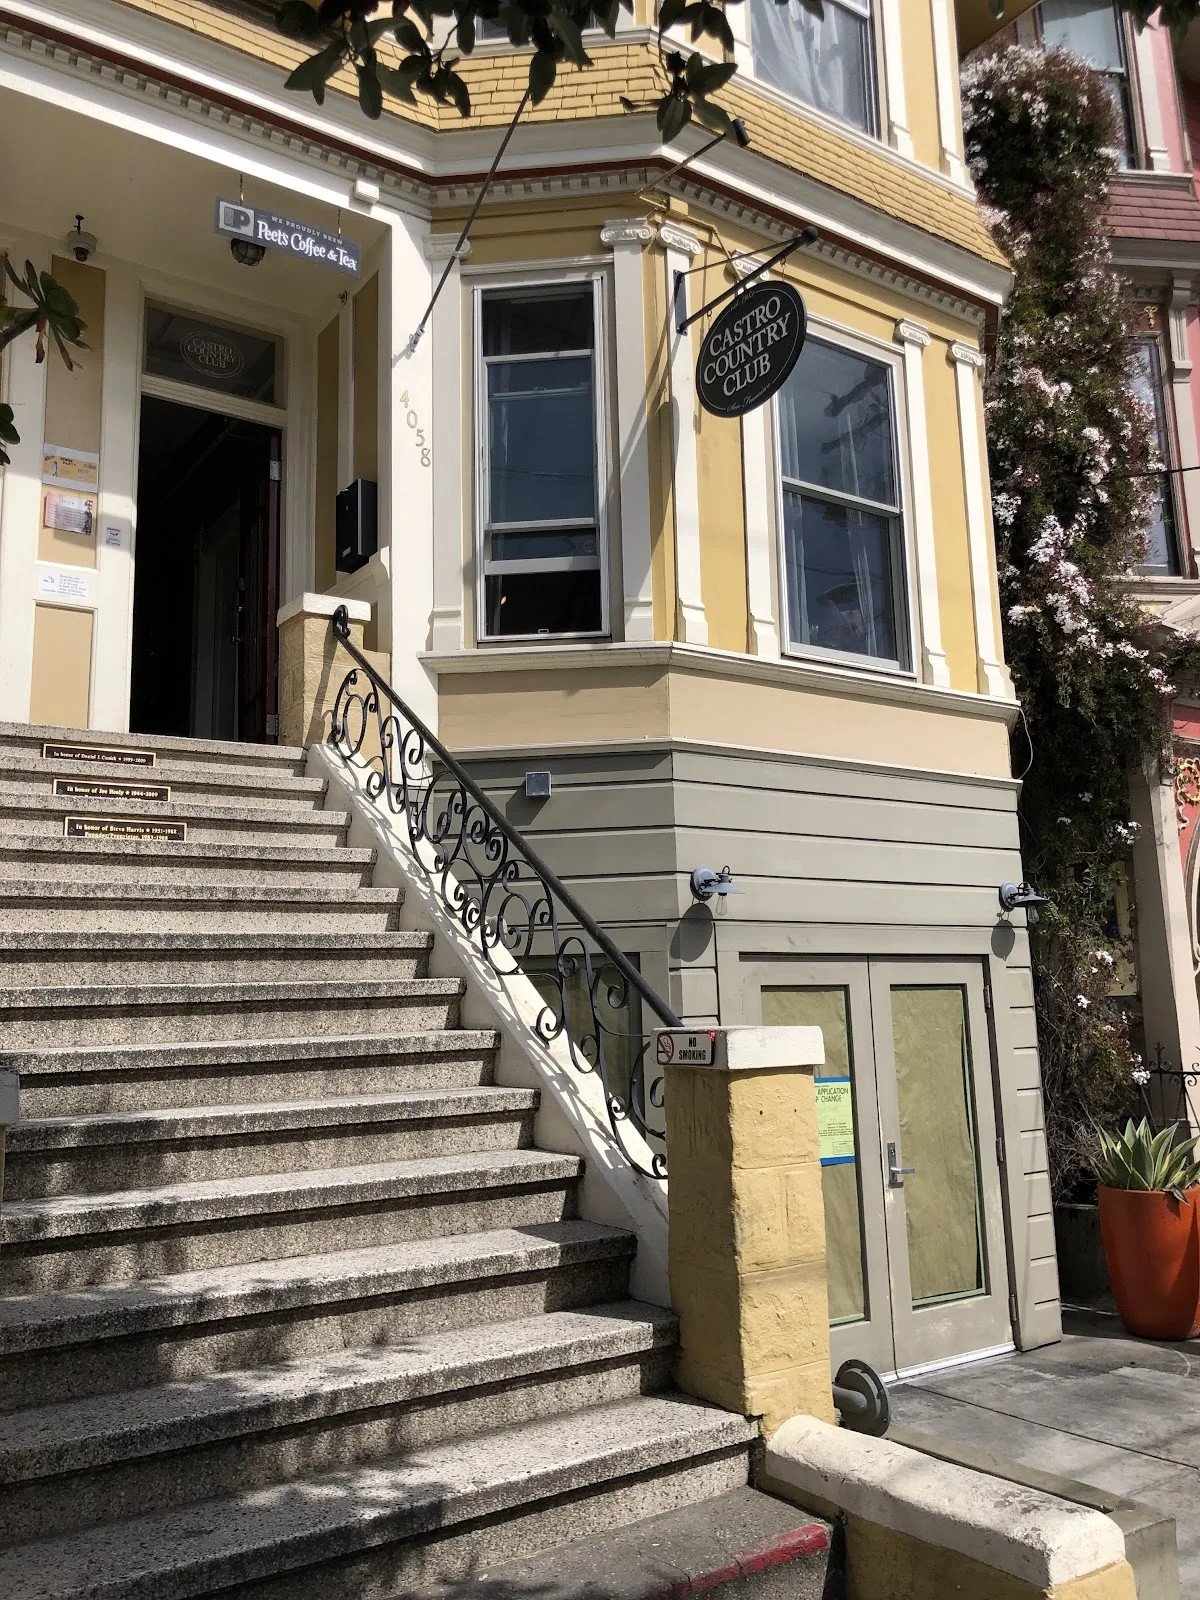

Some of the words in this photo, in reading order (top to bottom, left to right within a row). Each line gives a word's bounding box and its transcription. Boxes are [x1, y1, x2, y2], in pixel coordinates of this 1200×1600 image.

[271, 215, 283, 224] WE
[286, 220, 321, 237] PROUDLY
[323, 234, 343, 245] BREW
[256, 220, 289, 246] Peet's
[290, 233, 326, 258] Coffee
[327, 250, 338, 262] &
[336, 247, 358, 270] Tea
[709, 296, 781, 357] CASTRO
[187, 344, 237, 363] COUNTRY
[192, 338, 233, 355] CASTRO
[703, 312, 791, 384] COUNTRY
[198, 354, 226, 369] CLUB
[723, 353, 771, 397] CLUB
[400, 389, 431, 468] 4058
[109, 825, 125, 833] Steve
[688, 1036, 697, 1047] NO
[678, 1049, 706, 1061] SMOKING
[817, 1087, 849, 1095] APPLICATION
[820, 1095, 842, 1103] CHANGE
